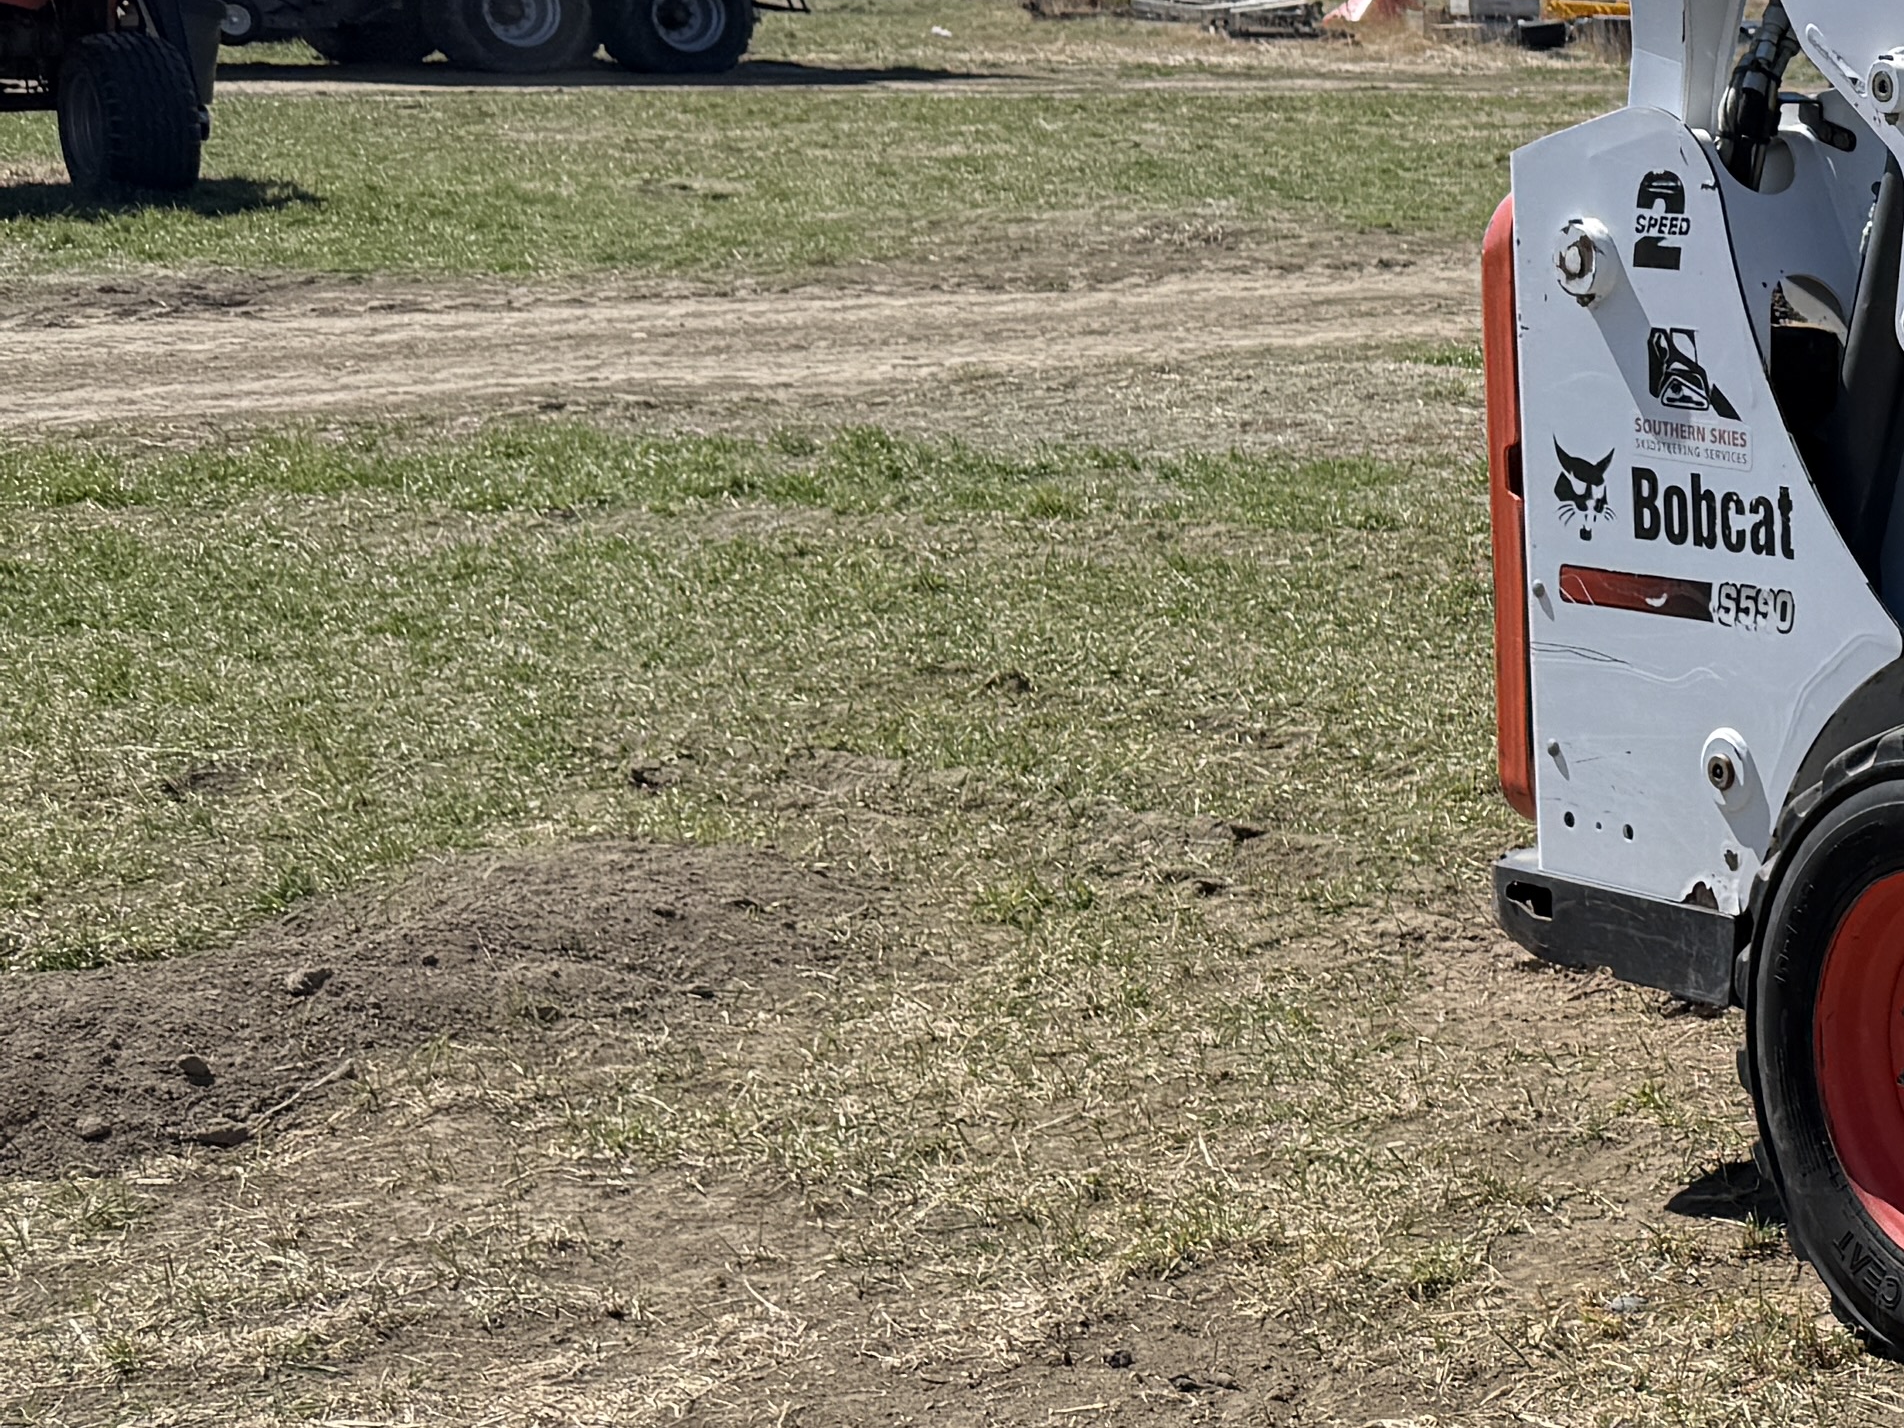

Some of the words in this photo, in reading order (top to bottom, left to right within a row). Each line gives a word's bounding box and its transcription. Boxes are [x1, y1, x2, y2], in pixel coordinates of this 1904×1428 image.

[1635, 214, 1691, 236] SPEED
[1634, 417, 1706, 443] SOUTHERN
[1710, 427, 1748, 448] SKIES
[1704, 448, 1748, 465] SERVICES
[1631, 466, 1795, 560] Bobcat
[1716, 581, 1796, 635] S590
[1831, 1229, 1904, 1310] CEAT
